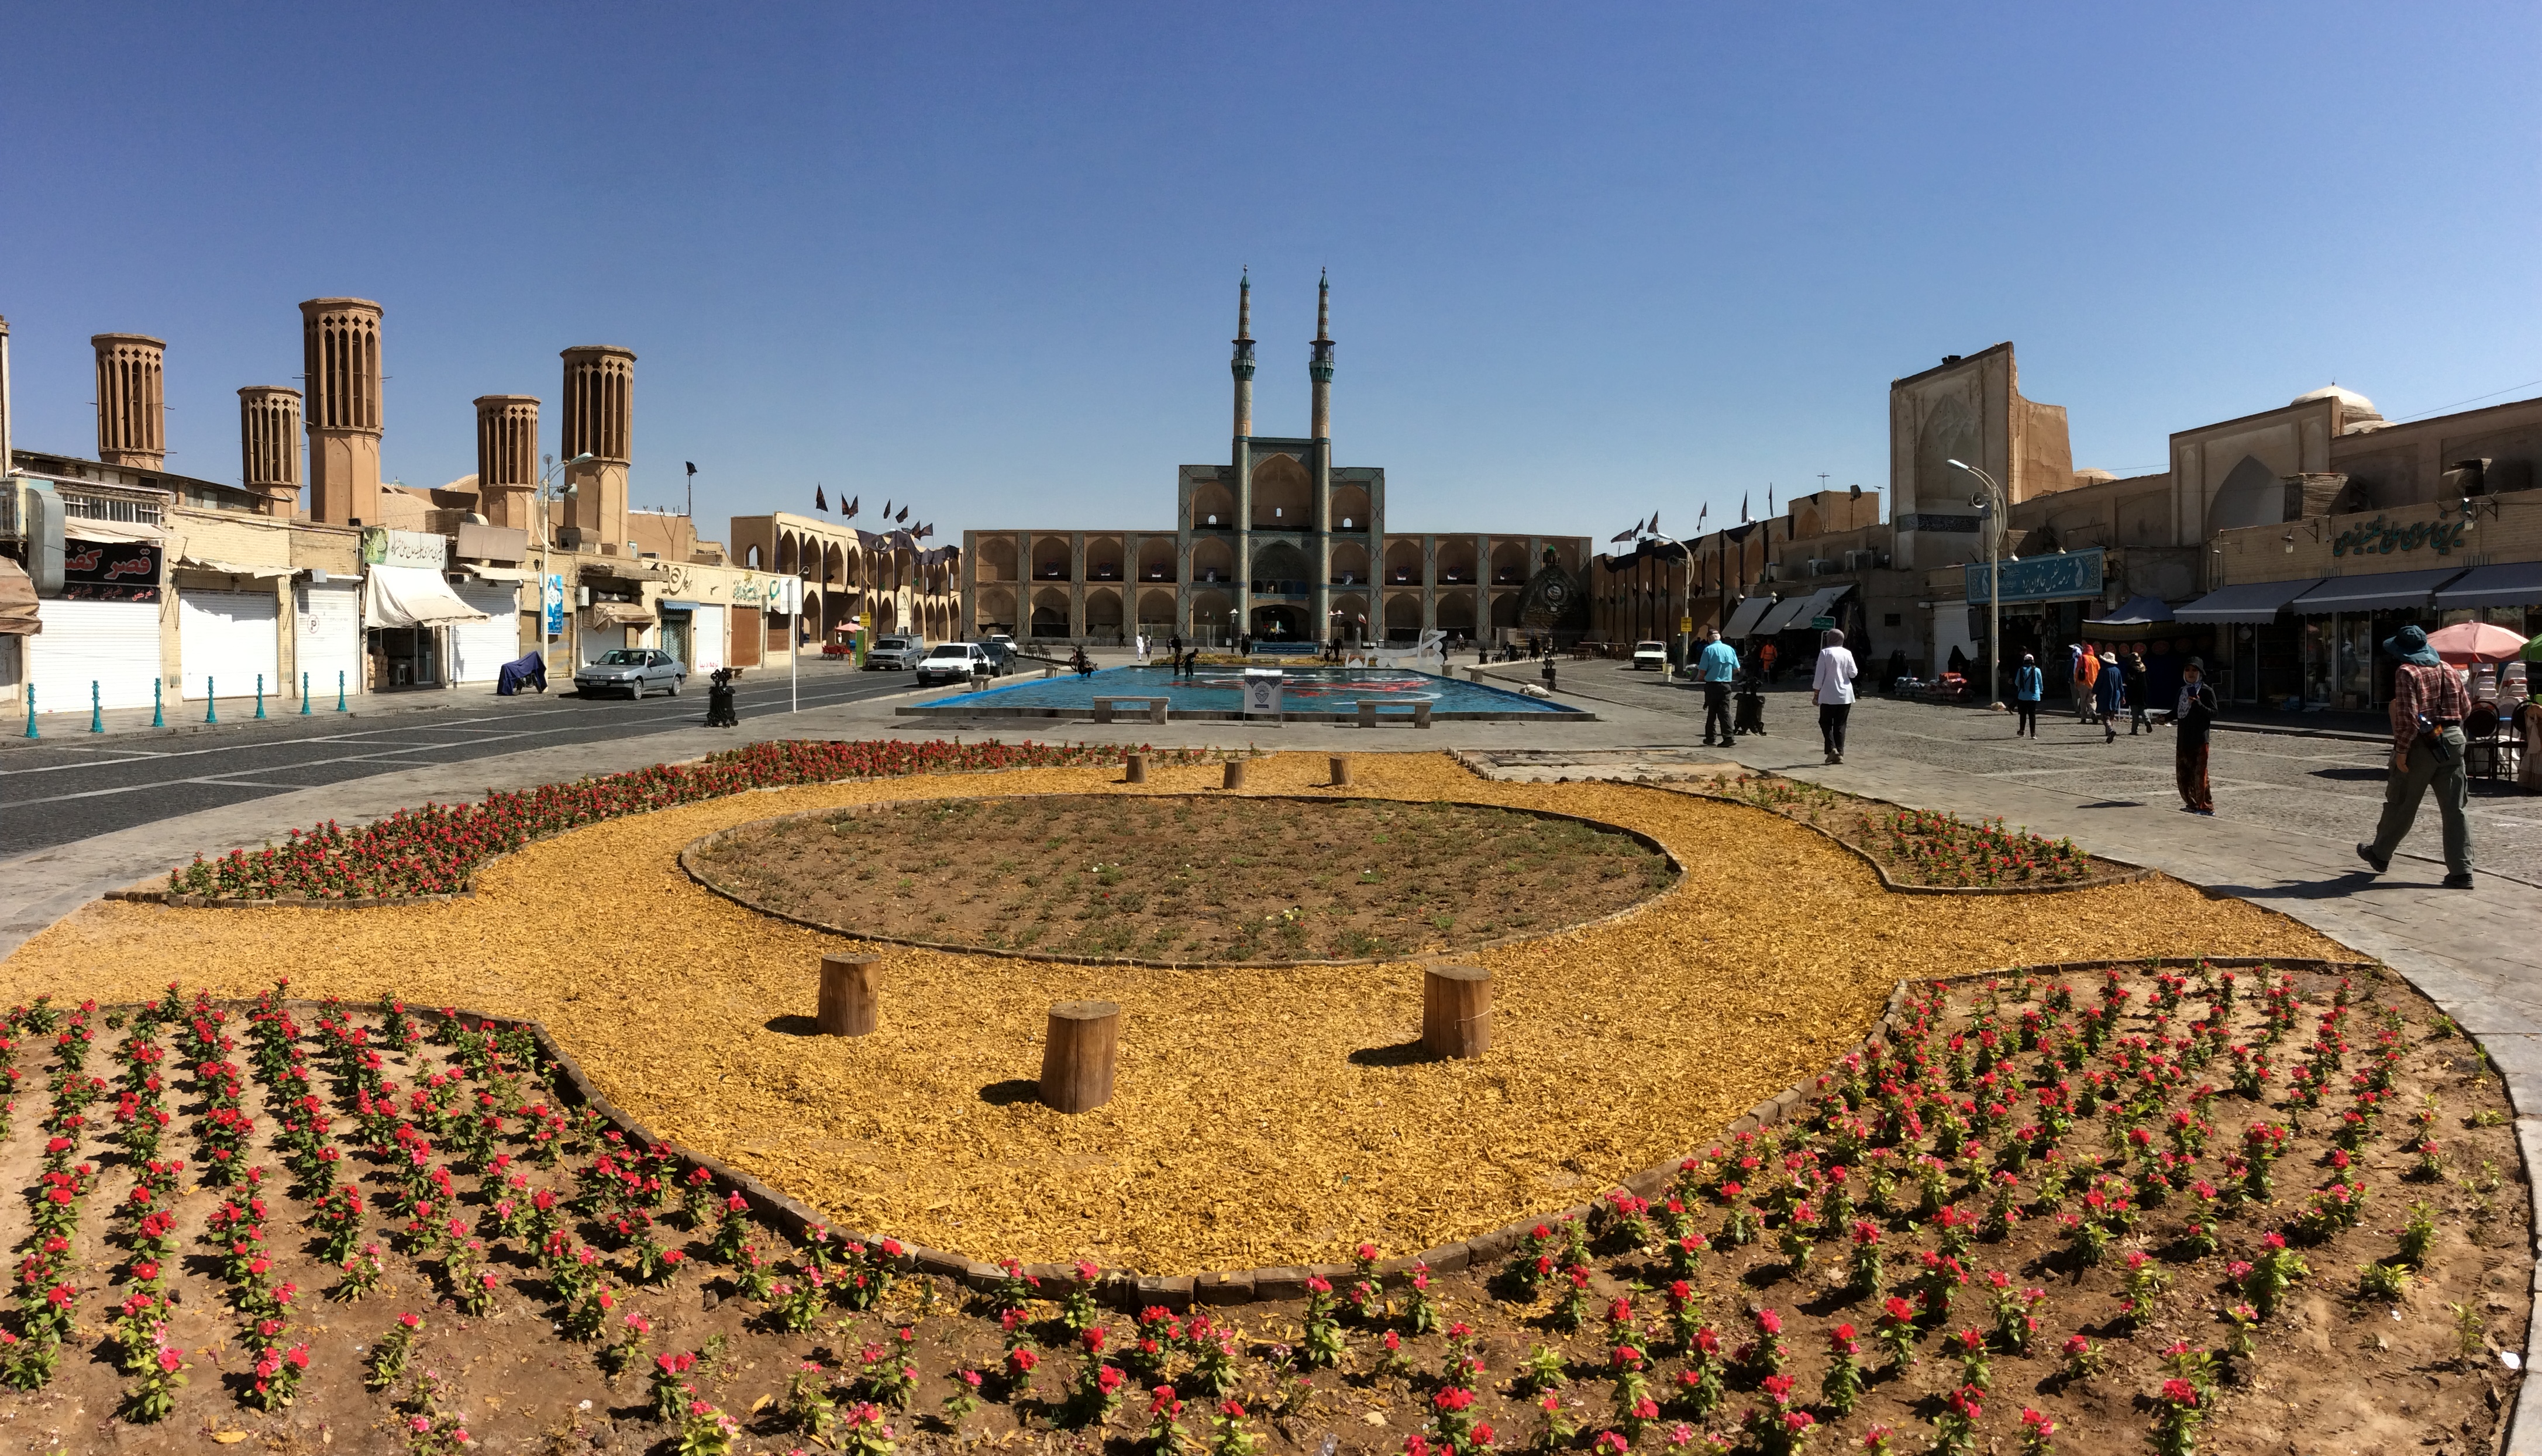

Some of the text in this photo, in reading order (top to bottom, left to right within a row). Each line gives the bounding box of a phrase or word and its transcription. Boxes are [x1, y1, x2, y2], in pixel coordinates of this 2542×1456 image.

[2333, 522, 2362, 557] یزدی
[2360, 515, 2383, 554] خلیفه
[2379, 522, 2401, 554] حاج
[2400, 522, 2437, 551] سرای
[407, 544, 415, 559] حاج
[422, 544, 433, 558] سرای
[432, 542, 444, 563] شیرینی
[104, 548, 151, 580] قصر
[2045, 558, 2059, 592] نفیس
[2058, 562, 2072, 585] ترمه
[2029, 564, 2045, 594] خاتون
[68, 584, 92, 599] قصر کفش
[100, 585, 123, 600] قصر کفش
[132, 586, 154, 601] قصر کفش
[700, 660, 719, 670] ترمه دیبا
